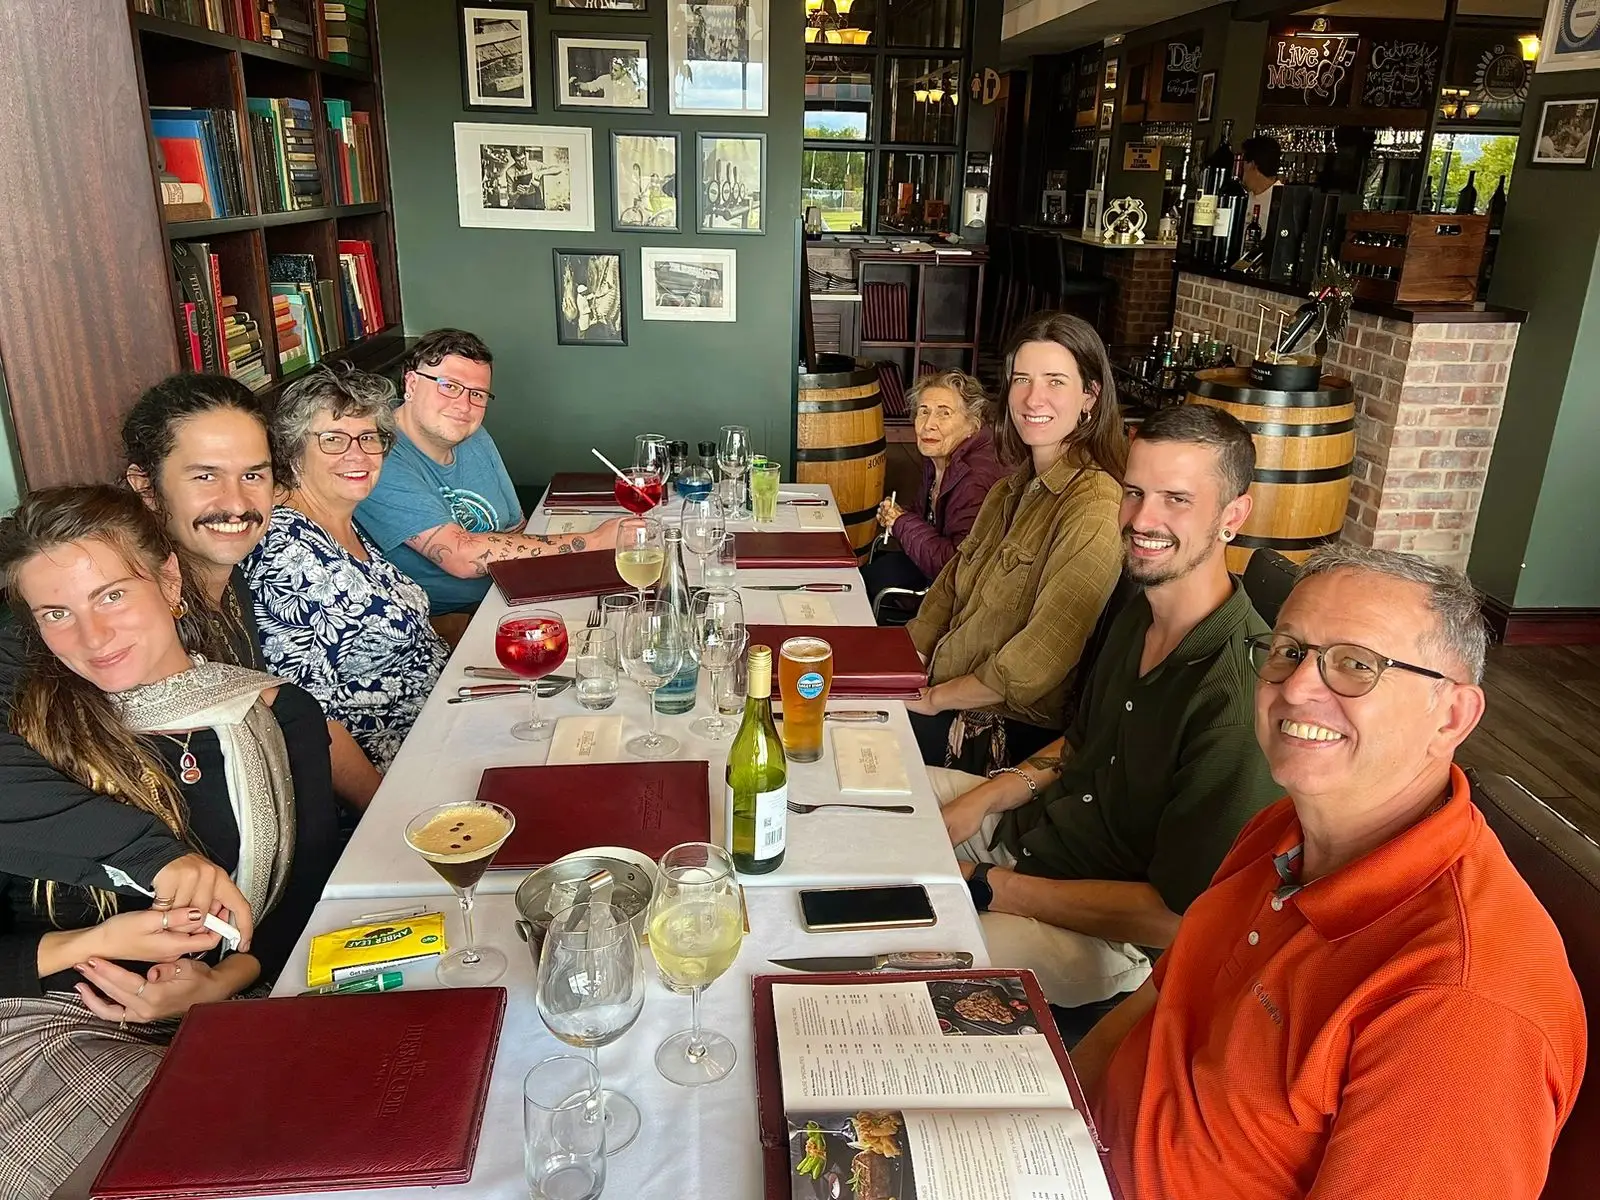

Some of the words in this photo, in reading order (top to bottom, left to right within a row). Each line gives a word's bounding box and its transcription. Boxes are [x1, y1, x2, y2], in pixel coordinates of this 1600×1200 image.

[1276, 41, 1319, 67] Live
[1266, 64, 1318, 89] Music
[348, 938, 373, 948] LEAF
[375, 928, 409, 944] AMBER
[349, 969, 361, 977] Get
